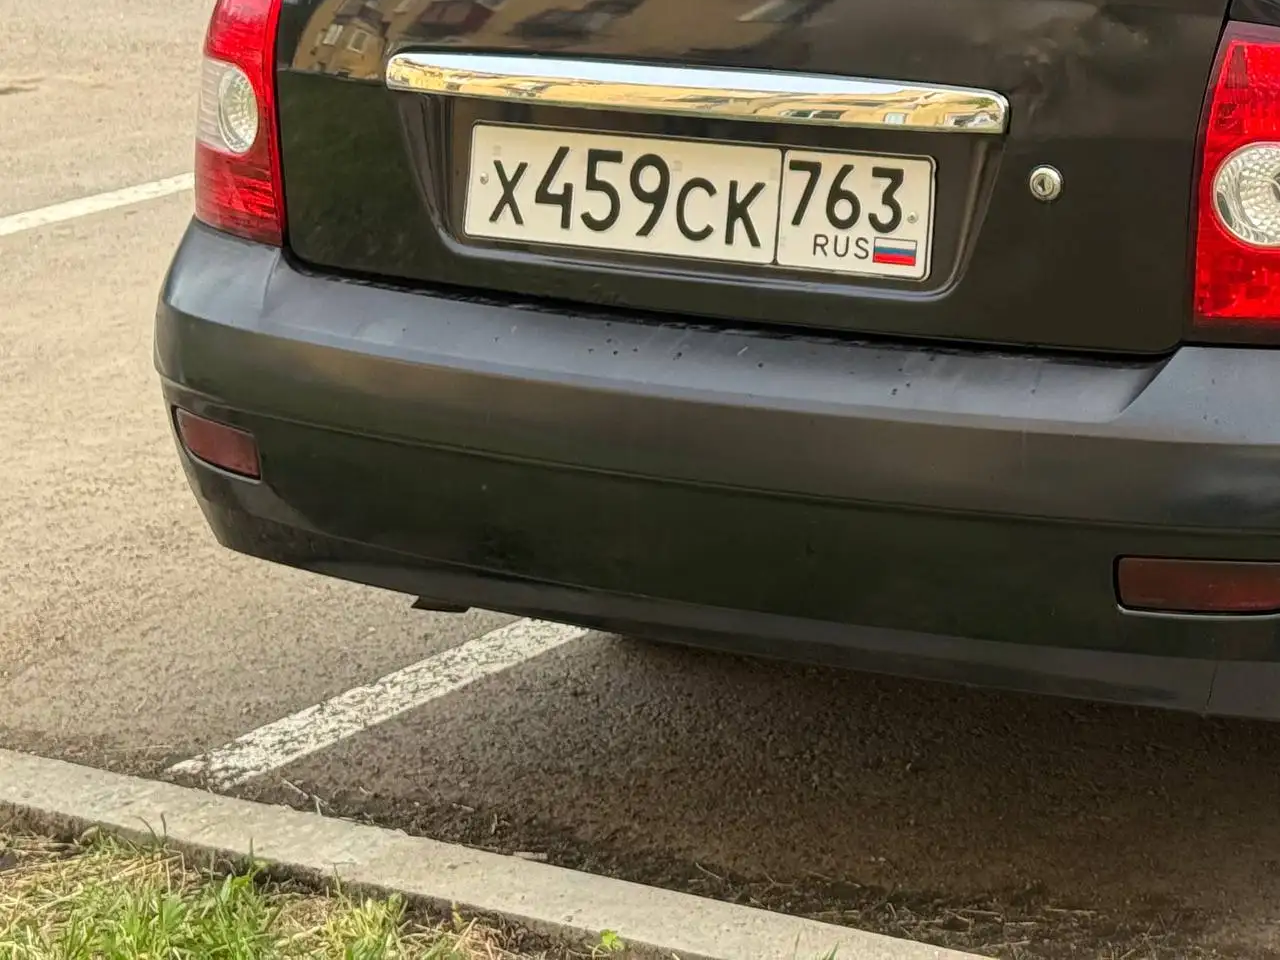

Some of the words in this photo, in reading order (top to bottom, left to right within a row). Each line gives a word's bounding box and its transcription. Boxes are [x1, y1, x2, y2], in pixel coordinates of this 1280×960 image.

[489, 145, 766, 248] Х459СК
[789, 160, 905, 234] 763
[812, 234, 870, 260] RUS
